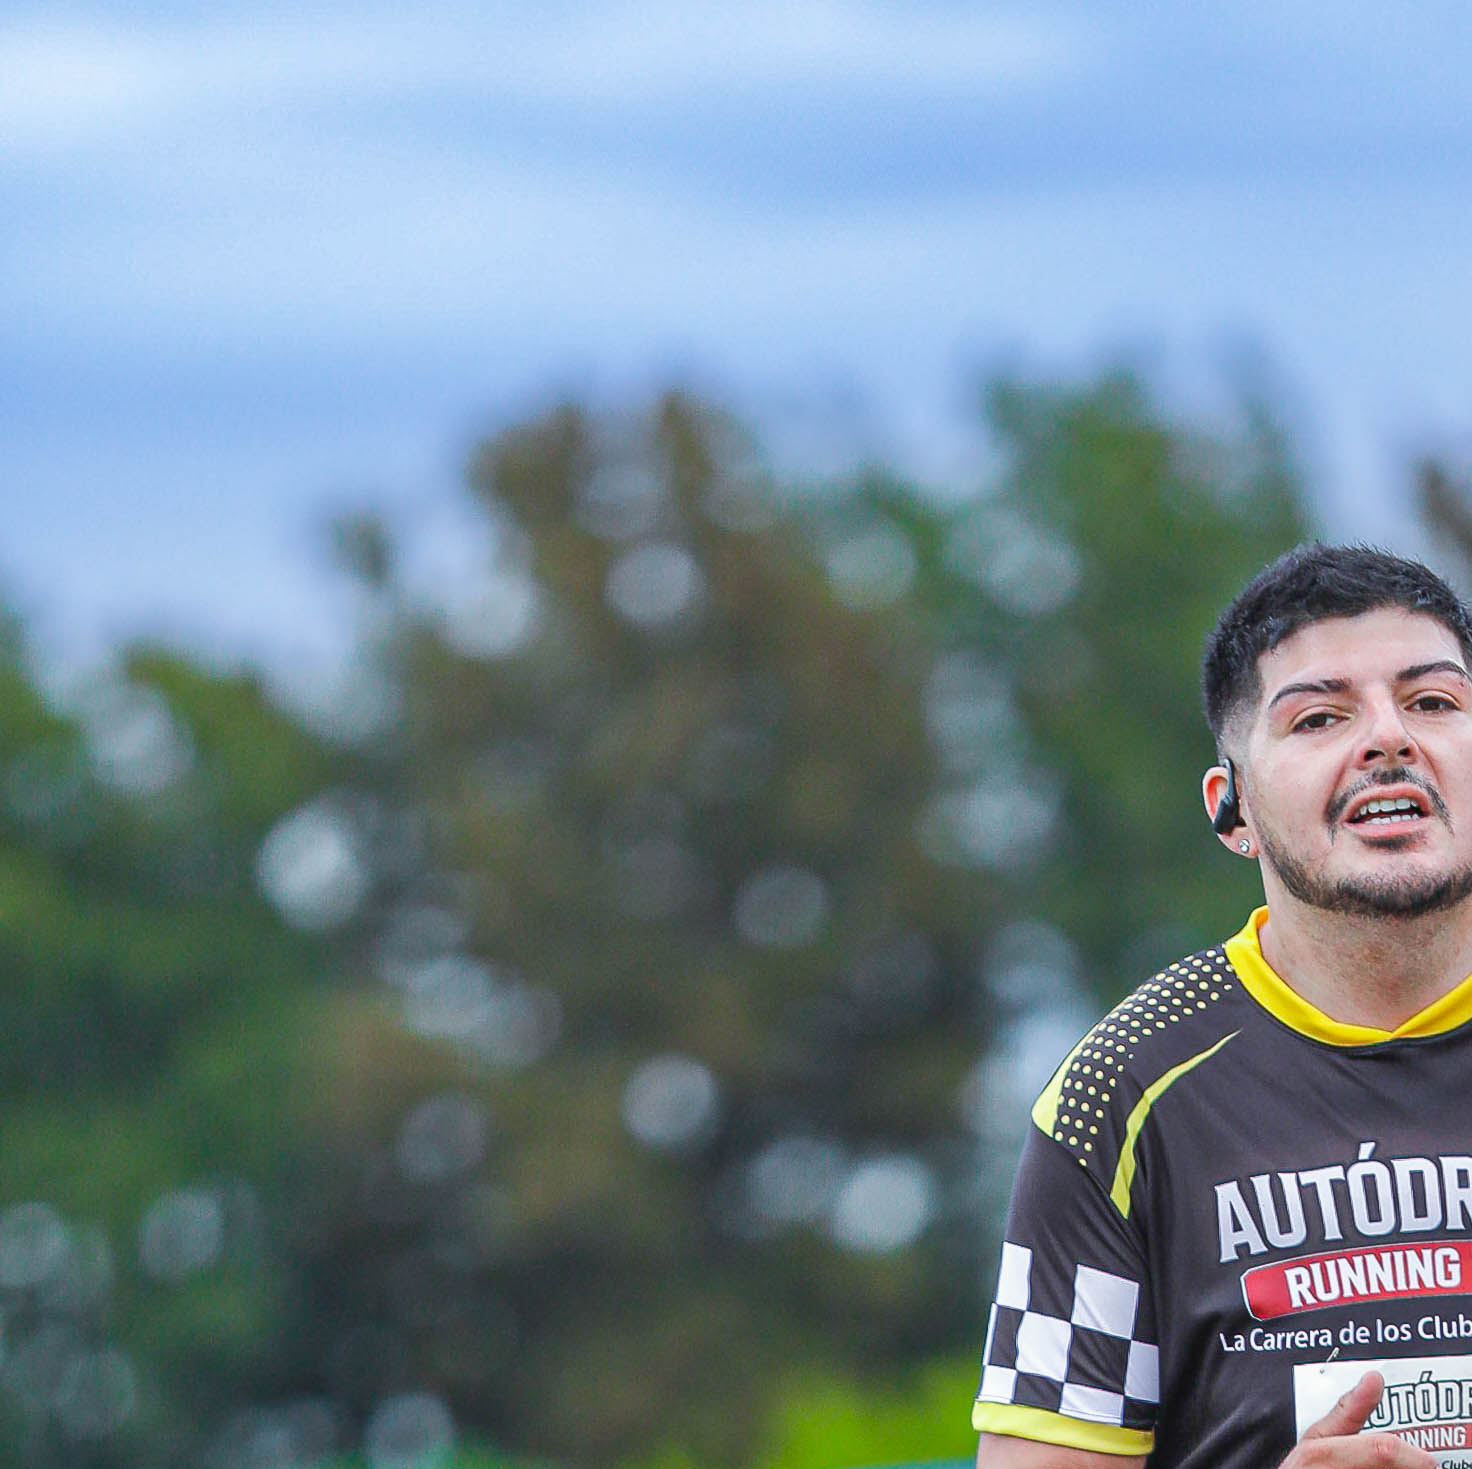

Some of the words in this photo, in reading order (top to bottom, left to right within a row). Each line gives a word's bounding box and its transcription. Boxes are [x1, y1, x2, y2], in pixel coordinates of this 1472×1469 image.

[1284, 1246, 1461, 1308] RUNNING
[1219, 1332, 1246, 1352] La
[1250, 1327, 1332, 1351] Carrera
[1339, 1320, 1370, 1345] de
[1376, 1318, 1412, 1343] los
[1396, 1426, 1466, 1450] NNING
